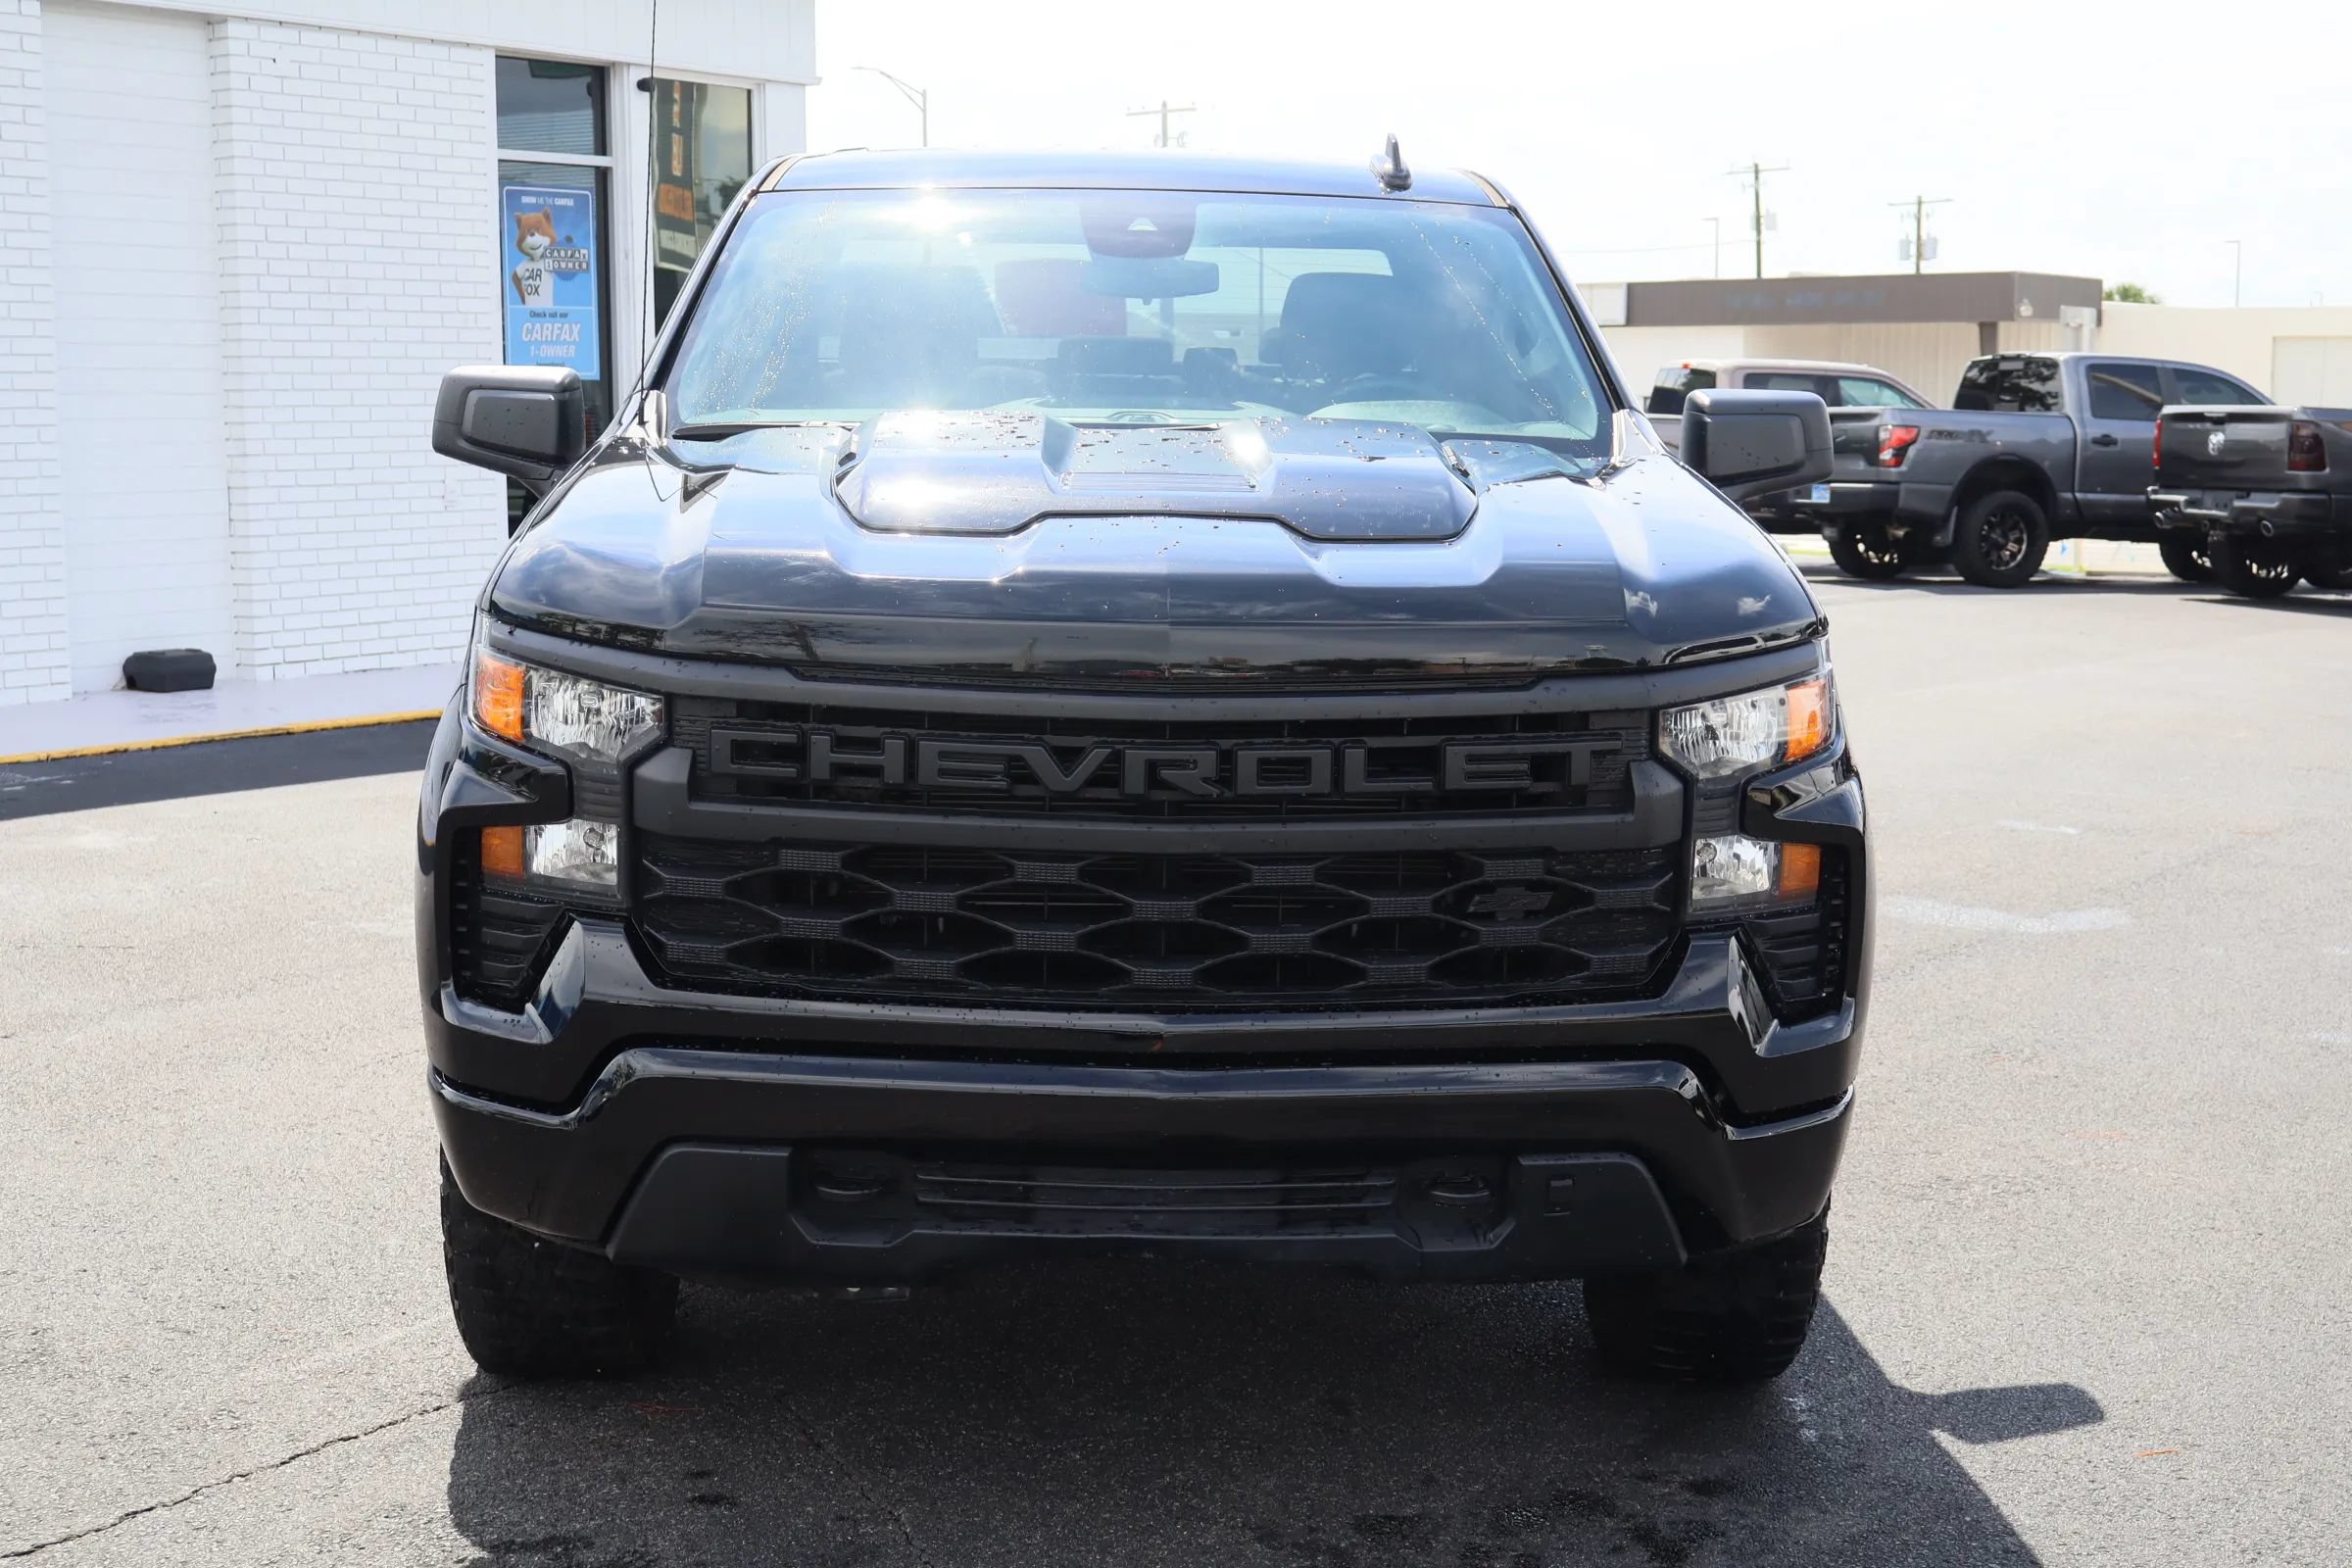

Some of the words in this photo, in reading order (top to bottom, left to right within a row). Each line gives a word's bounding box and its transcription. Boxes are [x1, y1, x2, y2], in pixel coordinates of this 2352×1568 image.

[546, 248, 588, 260] CARFAX
[524, 268, 543, 282] CAR
[529, 310, 547, 318] Check
[521, 321, 581, 342] CARFAX
[530, 344, 576, 358] 1-OWNER
[710, 727, 1623, 797] CHEVROLET
